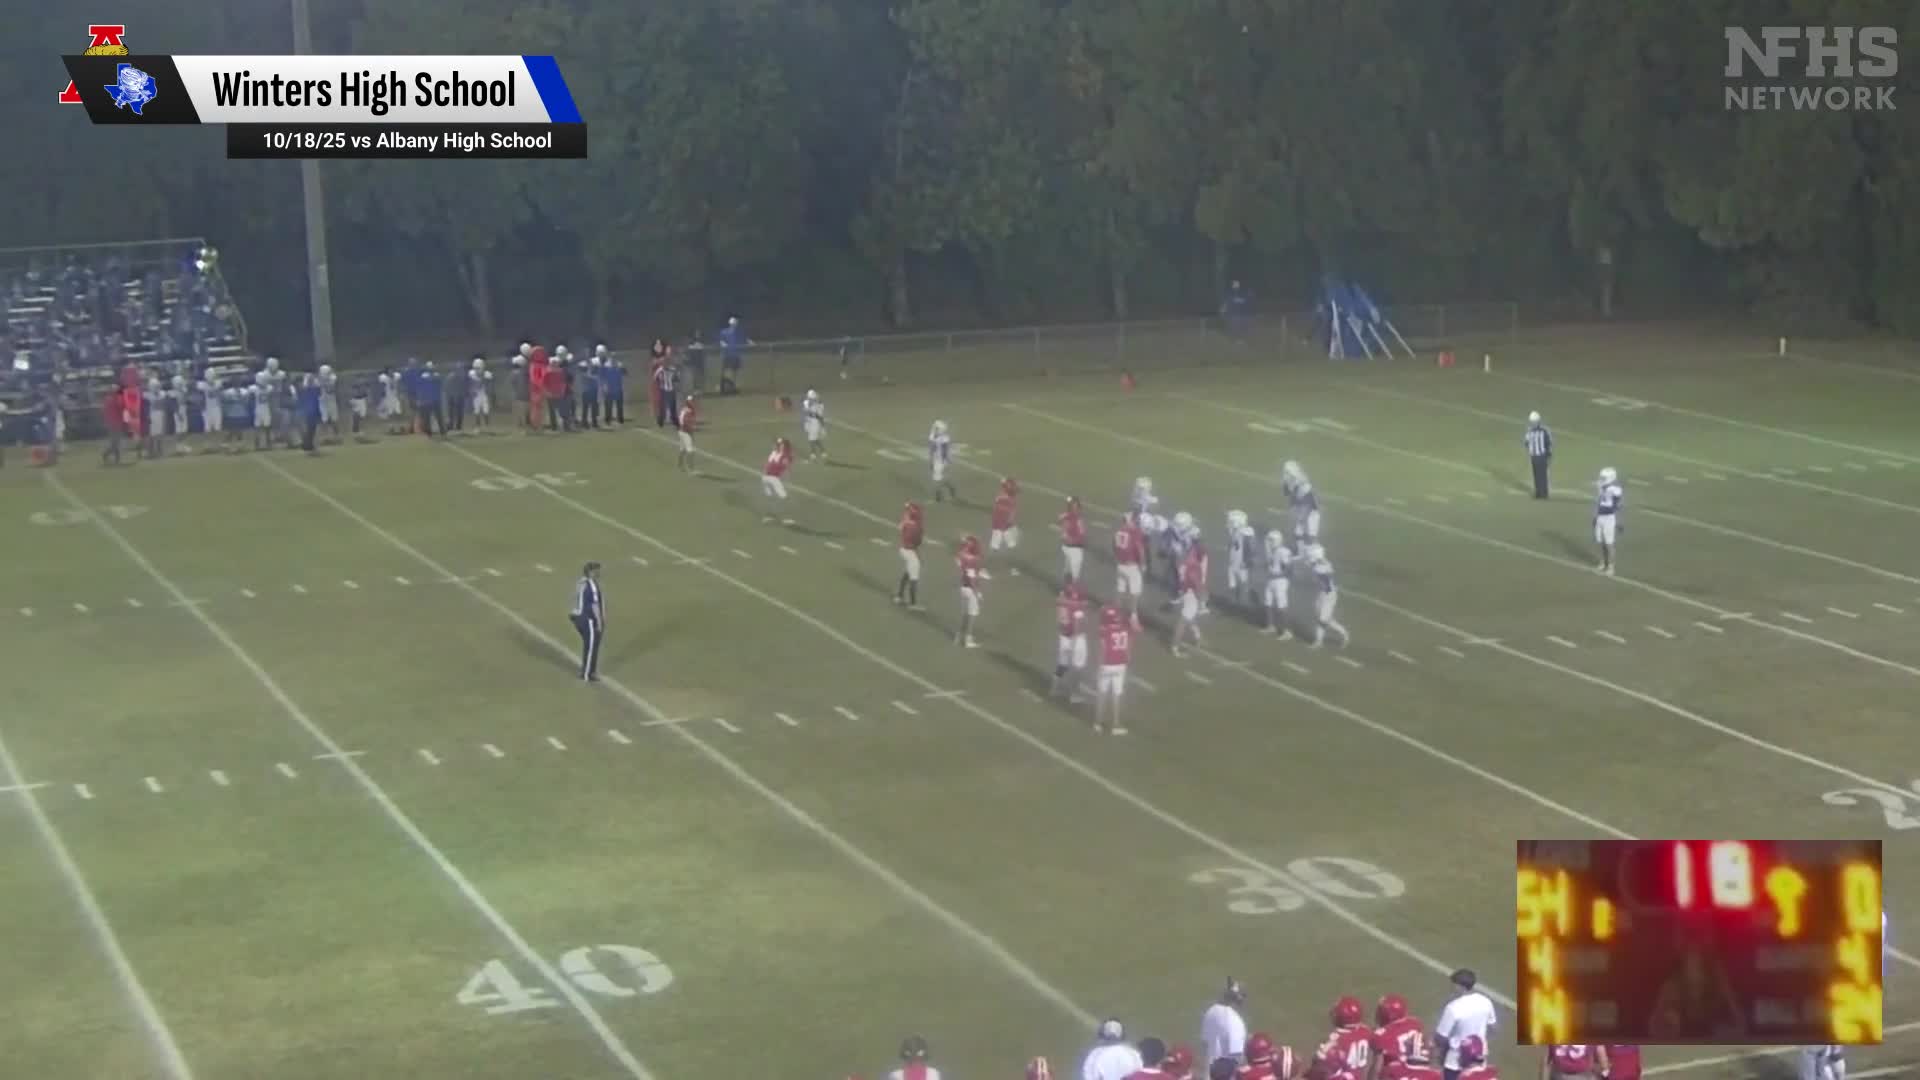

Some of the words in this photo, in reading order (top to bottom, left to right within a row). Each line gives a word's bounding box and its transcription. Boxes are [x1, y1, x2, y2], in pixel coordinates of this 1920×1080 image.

[1821, 778, 1920, 830] 2
[1187, 856, 1405, 914] 30
[456, 944, 673, 1015] 40
